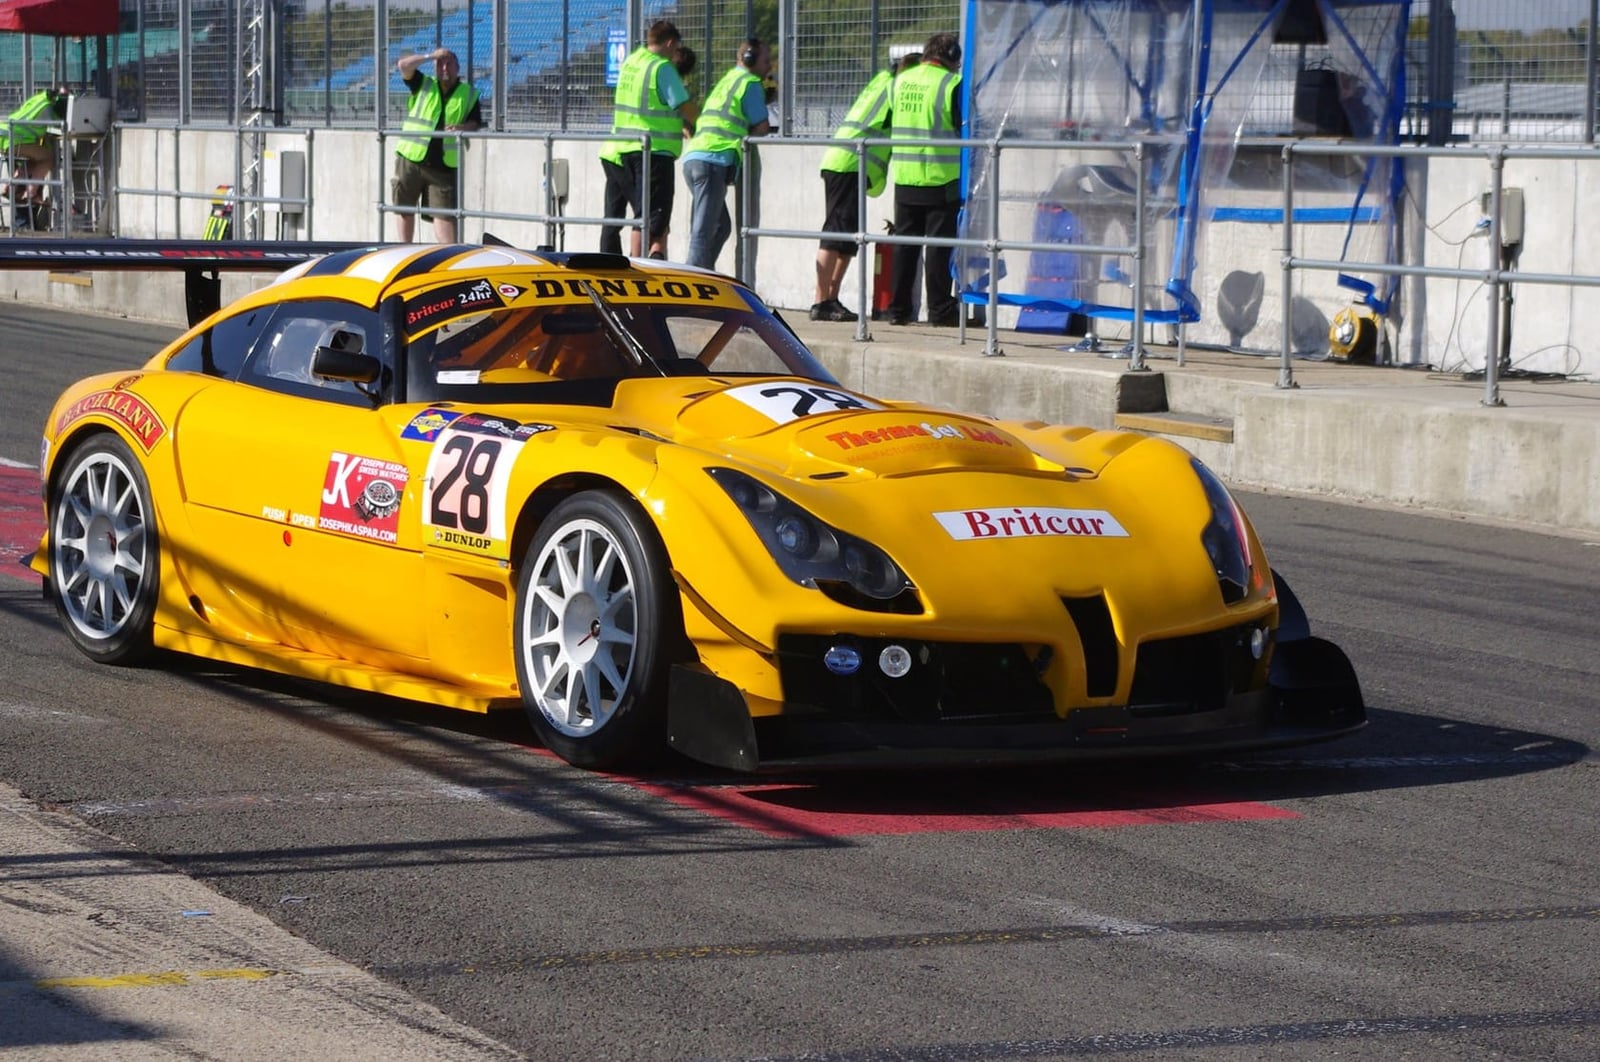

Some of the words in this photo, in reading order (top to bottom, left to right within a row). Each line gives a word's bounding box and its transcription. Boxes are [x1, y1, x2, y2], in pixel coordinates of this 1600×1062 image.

[901, 92, 924, 101] 24HR
[901, 103, 922, 112] 2011
[531, 279, 720, 300] DUNLOP
[407, 298, 455, 324] Britcar
[459, 290, 492, 304] 24hr
[431, 435, 502, 534] 28
[262, 506, 285, 520] PUSH
[291, 512, 316, 528] OPEN
[961, 509, 1105, 537] Britcar
[444, 532, 491, 549] DUNLOP
